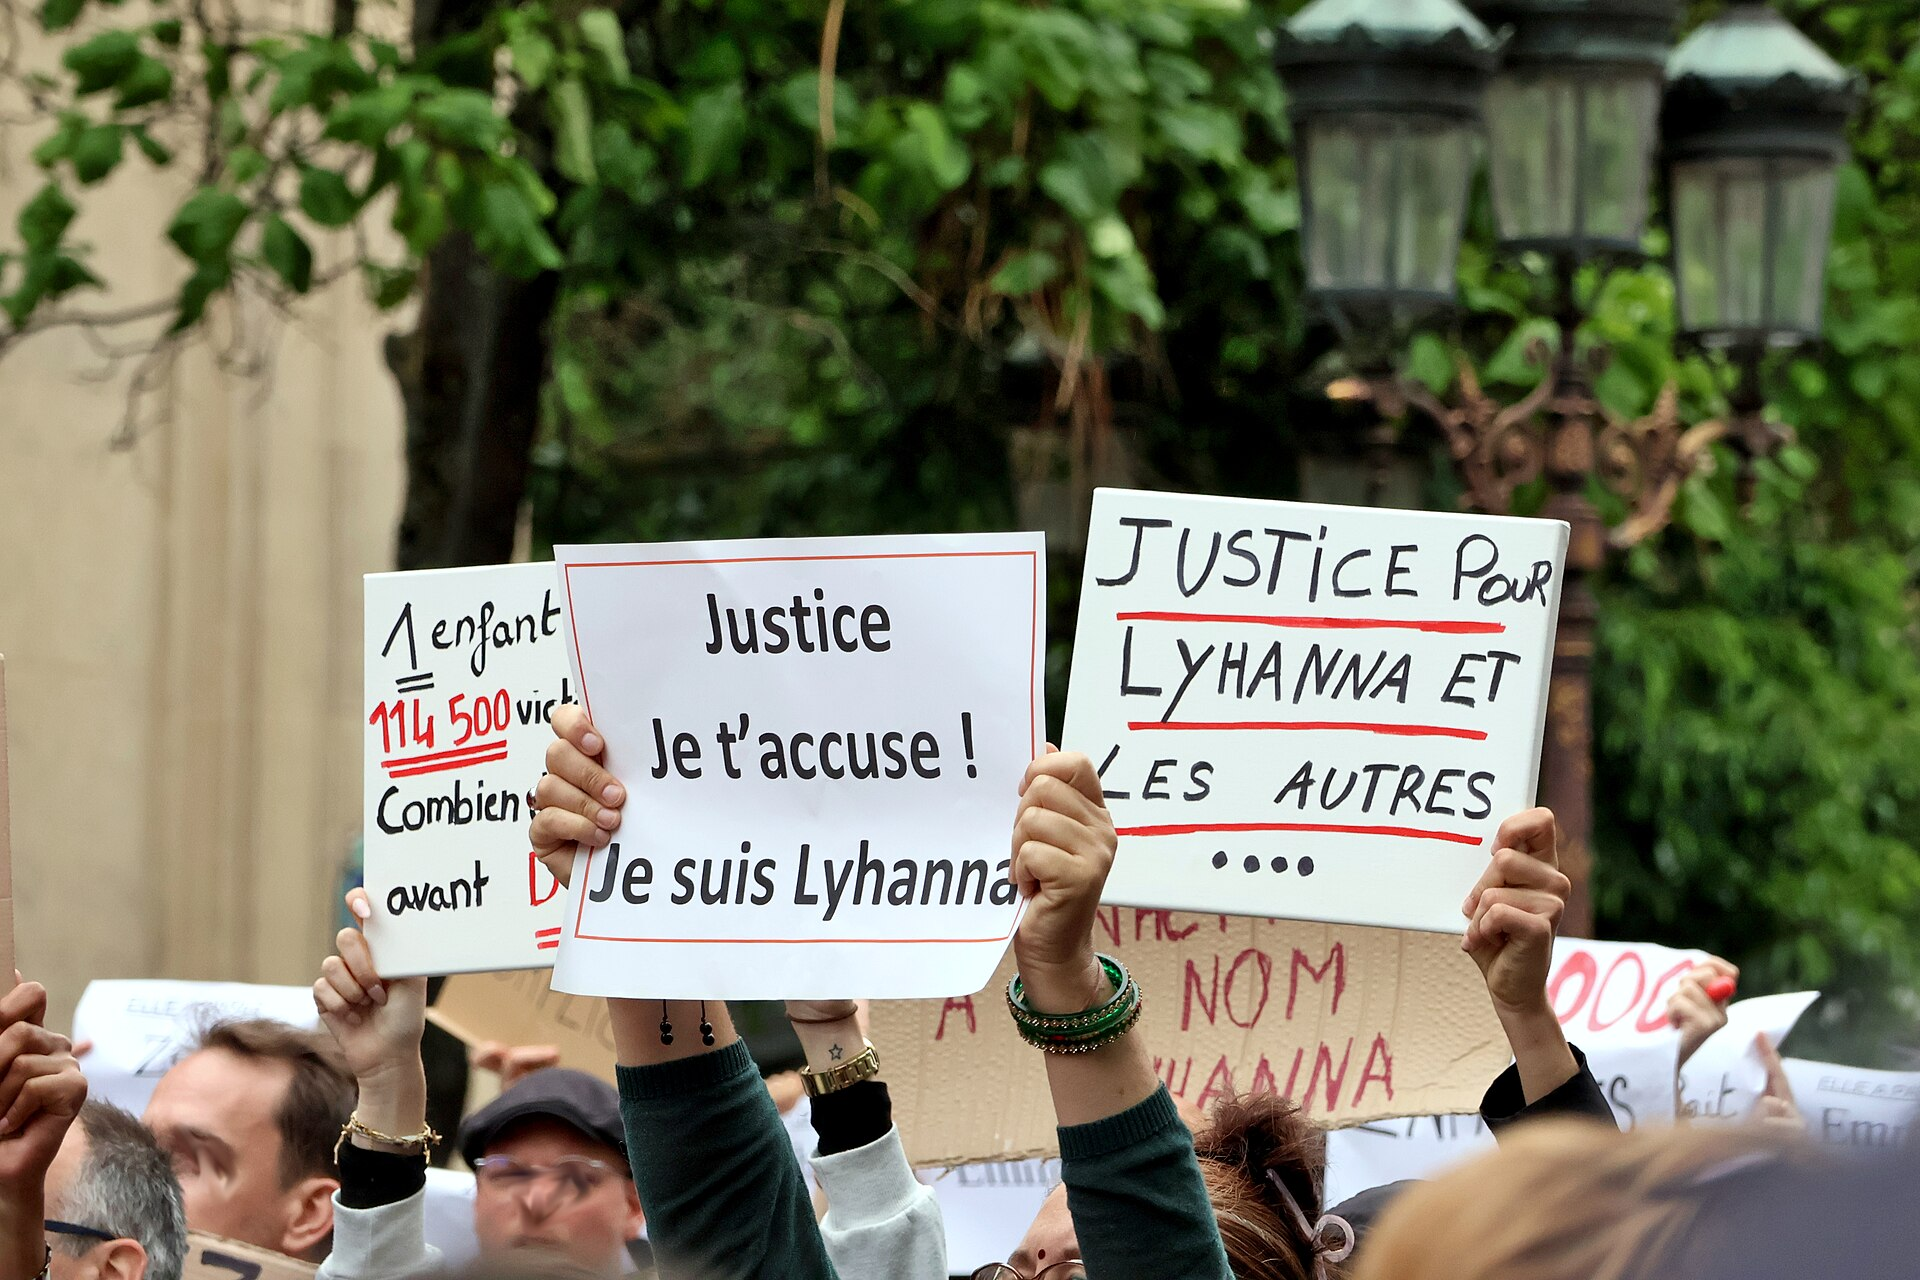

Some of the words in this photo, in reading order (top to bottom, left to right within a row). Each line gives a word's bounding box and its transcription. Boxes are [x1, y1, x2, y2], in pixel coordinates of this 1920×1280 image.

[381, 601, 418, 670] 1
[432, 589, 561, 677] enfant
[705, 587, 892, 655] Justice
[1440, 650, 1522, 709] ET
[369, 698, 435, 753] 114
[448, 688, 511, 747] 500
[651, 717, 702, 780] Je
[961, 711, 979, 779] !
[376, 779, 520, 835] Combien
[1097, 744, 1214, 802] LES
[1274, 760, 1496, 820] AUTRES
[386, 859, 490, 916] avant
[588, 842, 653, 904] Je
[670, 840, 777, 905] suis
[793, 839, 1017, 922] Lyhanna
[1180, 941, 1347, 1032] NOM
